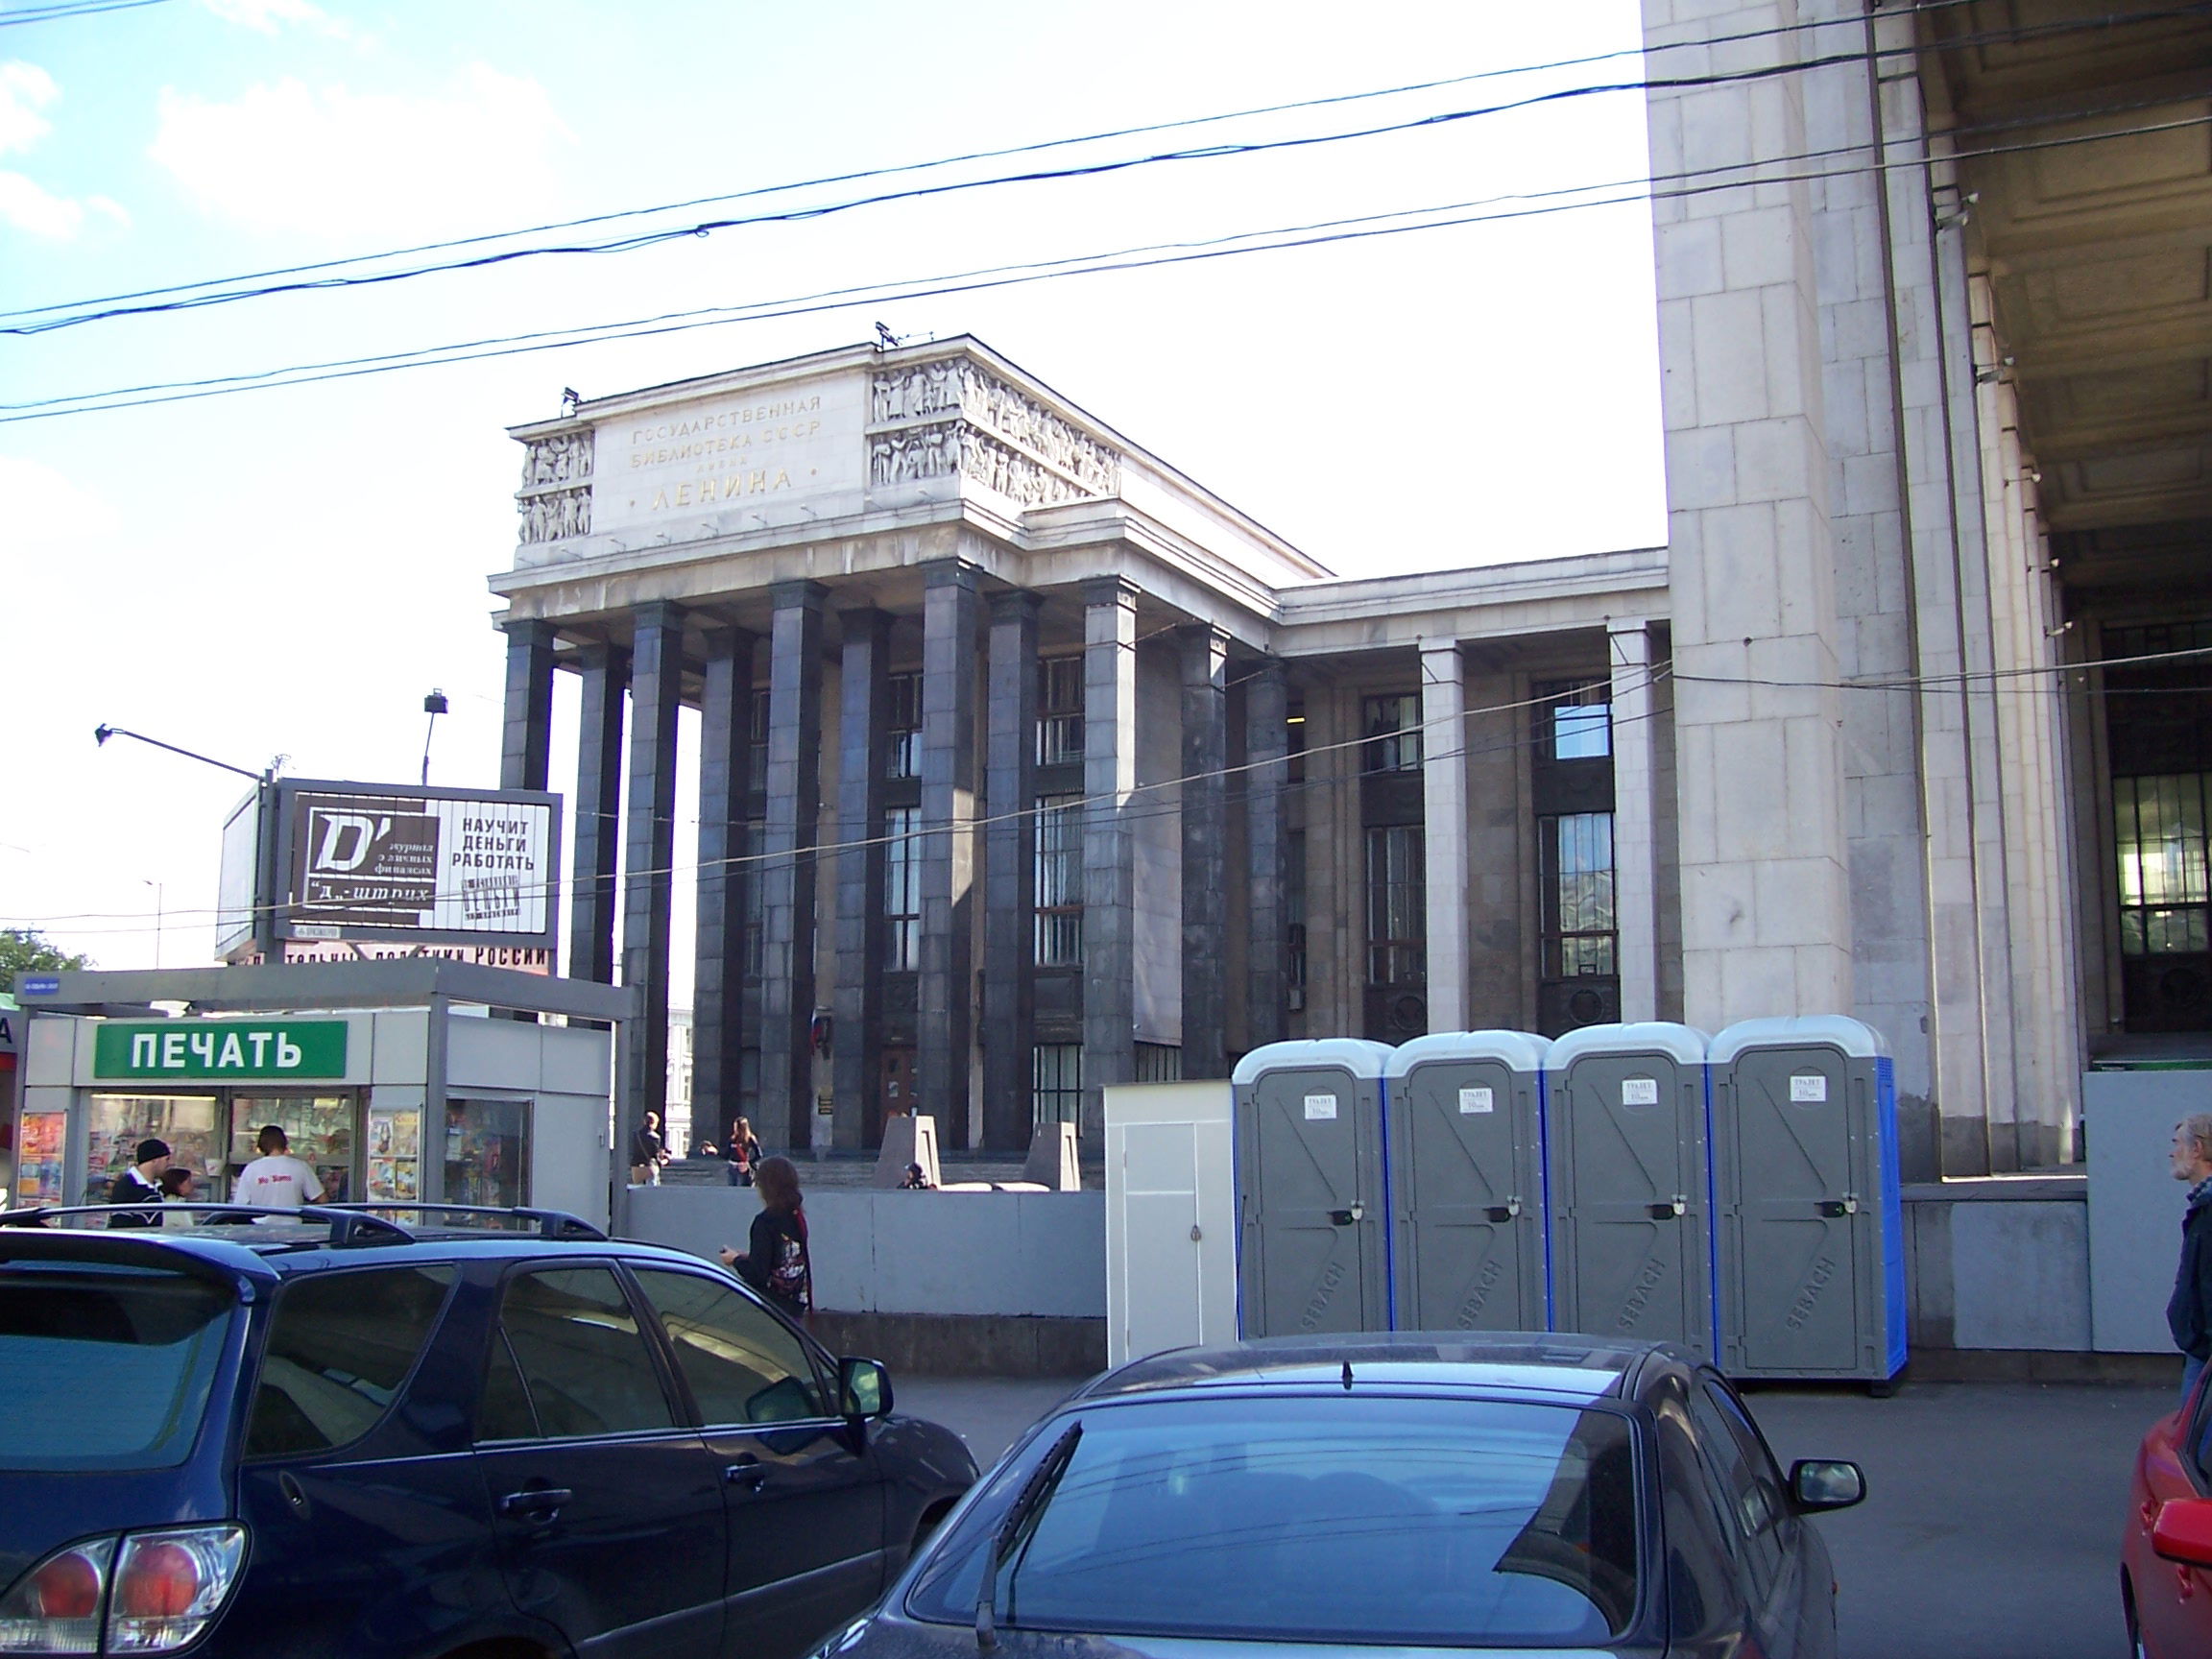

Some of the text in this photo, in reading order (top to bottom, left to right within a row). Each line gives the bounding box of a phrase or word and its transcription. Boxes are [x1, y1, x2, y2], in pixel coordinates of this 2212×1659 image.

[632, 396, 822, 445] ГОСУДАРСТВЕННАЯ
[630, 421, 821, 469] БИБЛИОТЕКА СССР
[652, 467, 792, 511] ЛЕНИНА
[462, 817, 529, 835] НАУЧИТ
[463, 834, 527, 853] ДЕНЬГИ
[374, 862, 433, 876] финансах
[452, 852, 535, 871] РАБОТАТЬ
[475, 947, 545, 966] РОССИИ
[132, 1032, 302, 1069] ПЕЧАТЬ
[1301, 1261, 1346, 1330] SEBACH
[1457, 1259, 1503, 1330] SEBACH
[1618, 1258, 1666, 1330] SEBACH
[1786, 1257, 1836, 1330] SEBACH
